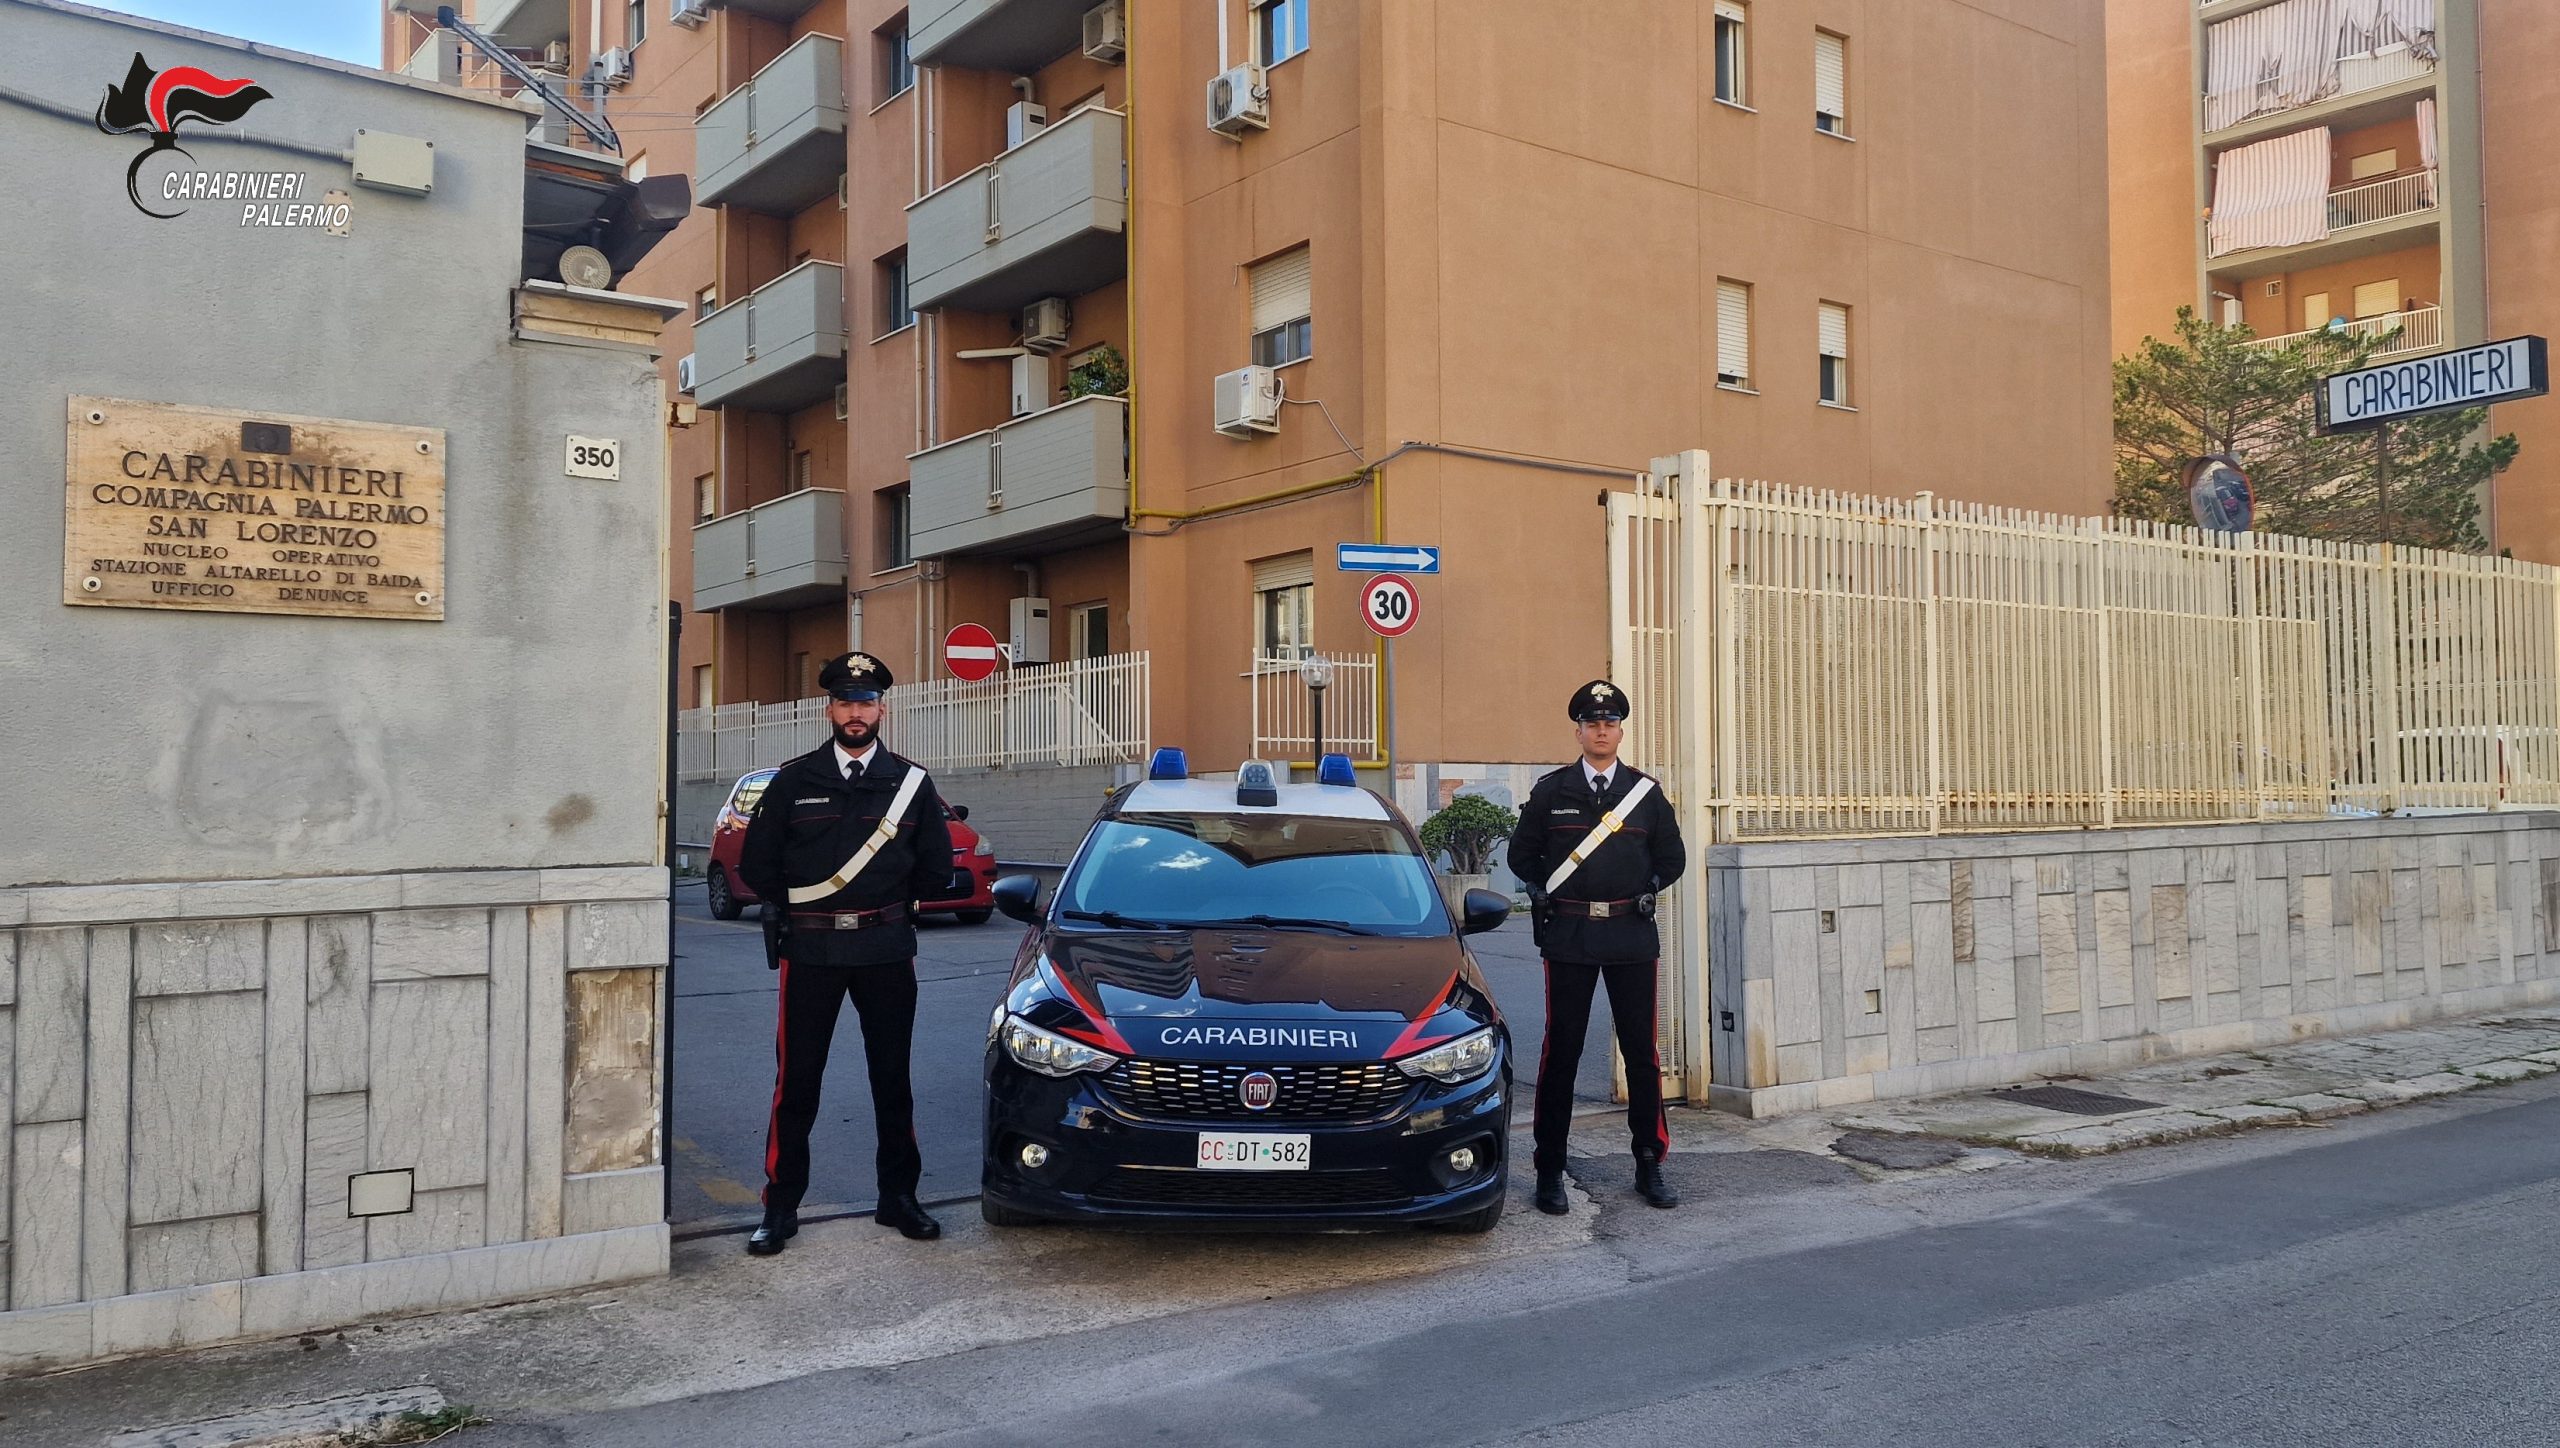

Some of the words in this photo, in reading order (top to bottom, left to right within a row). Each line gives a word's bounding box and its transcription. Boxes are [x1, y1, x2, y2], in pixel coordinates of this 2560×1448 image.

[2345, 345, 2515, 418] CARABINIERI
[573, 446, 615, 468] 350
[121, 450, 404, 498] CARABINIERI
[92, 483, 278, 516] COMPAGNIA
[294, 497, 429, 525] PALERMO
[147, 515, 208, 540] SAN
[237, 519, 377, 549] LORENZO
[143, 542, 229, 560] NUCLEO
[272, 549, 381, 568] OPERATIVO
[91, 558, 187, 577] STAZIONE
[204, 565, 321, 583] ALTARELLO
[336, 572, 355, 585] DI
[367, 573, 423, 589] BAIDA
[152, 581, 235, 598] UFFICIO
[278, 586, 368, 604] DENUNCE
[1374, 590, 1407, 620] 30
[1160, 1027, 1358, 1048] CARABINIERI
[1248, 1083, 1271, 1100] FIAT
[1271, 1142, 1308, 1162] 582
